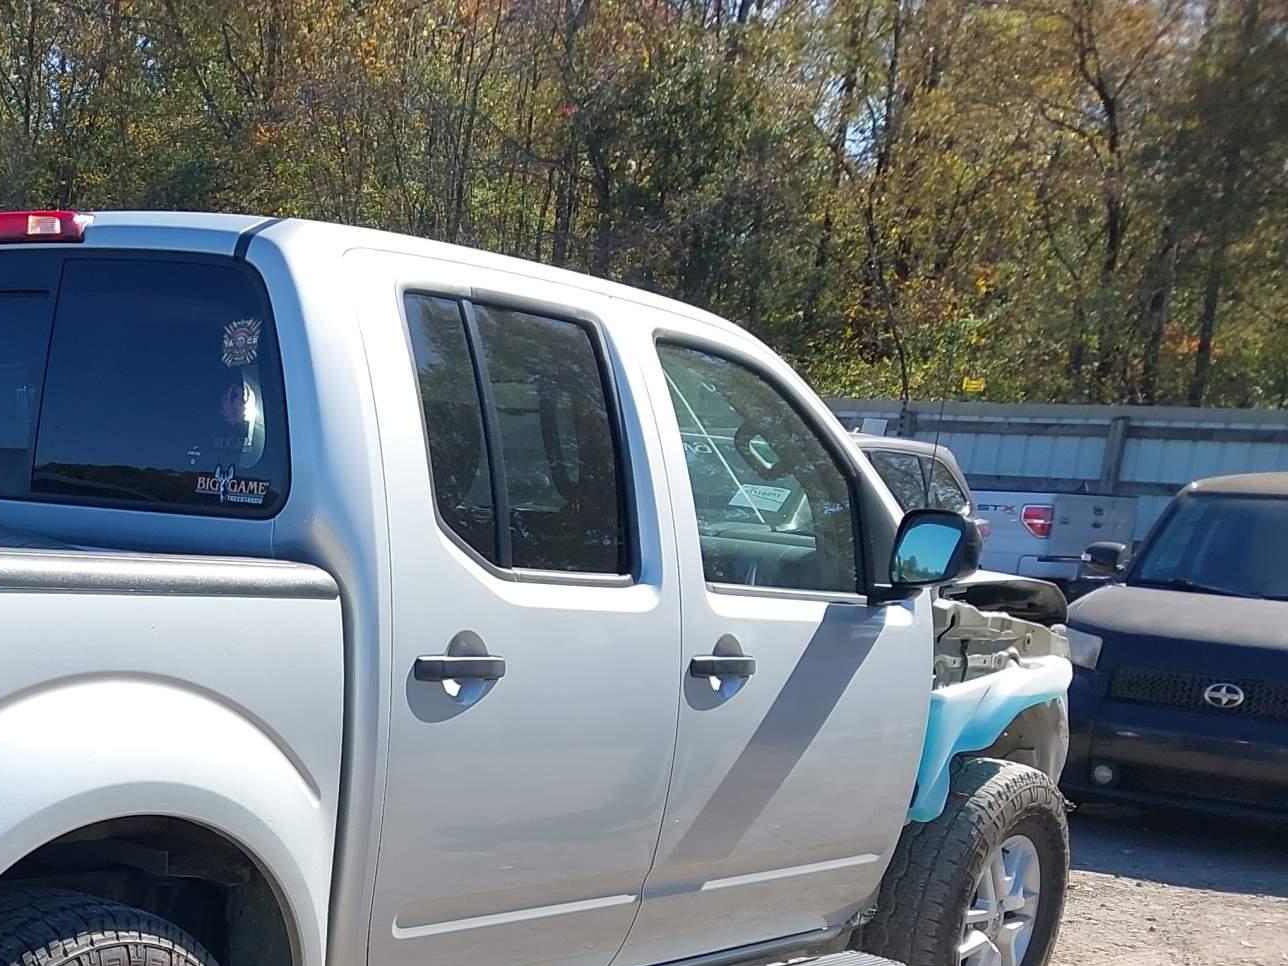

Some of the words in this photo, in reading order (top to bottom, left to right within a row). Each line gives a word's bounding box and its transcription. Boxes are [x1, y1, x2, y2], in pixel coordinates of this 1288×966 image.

[196, 476, 219, 491] BIG
[228, 479, 267, 495] GAME
[977, 504, 1016, 513] STX
